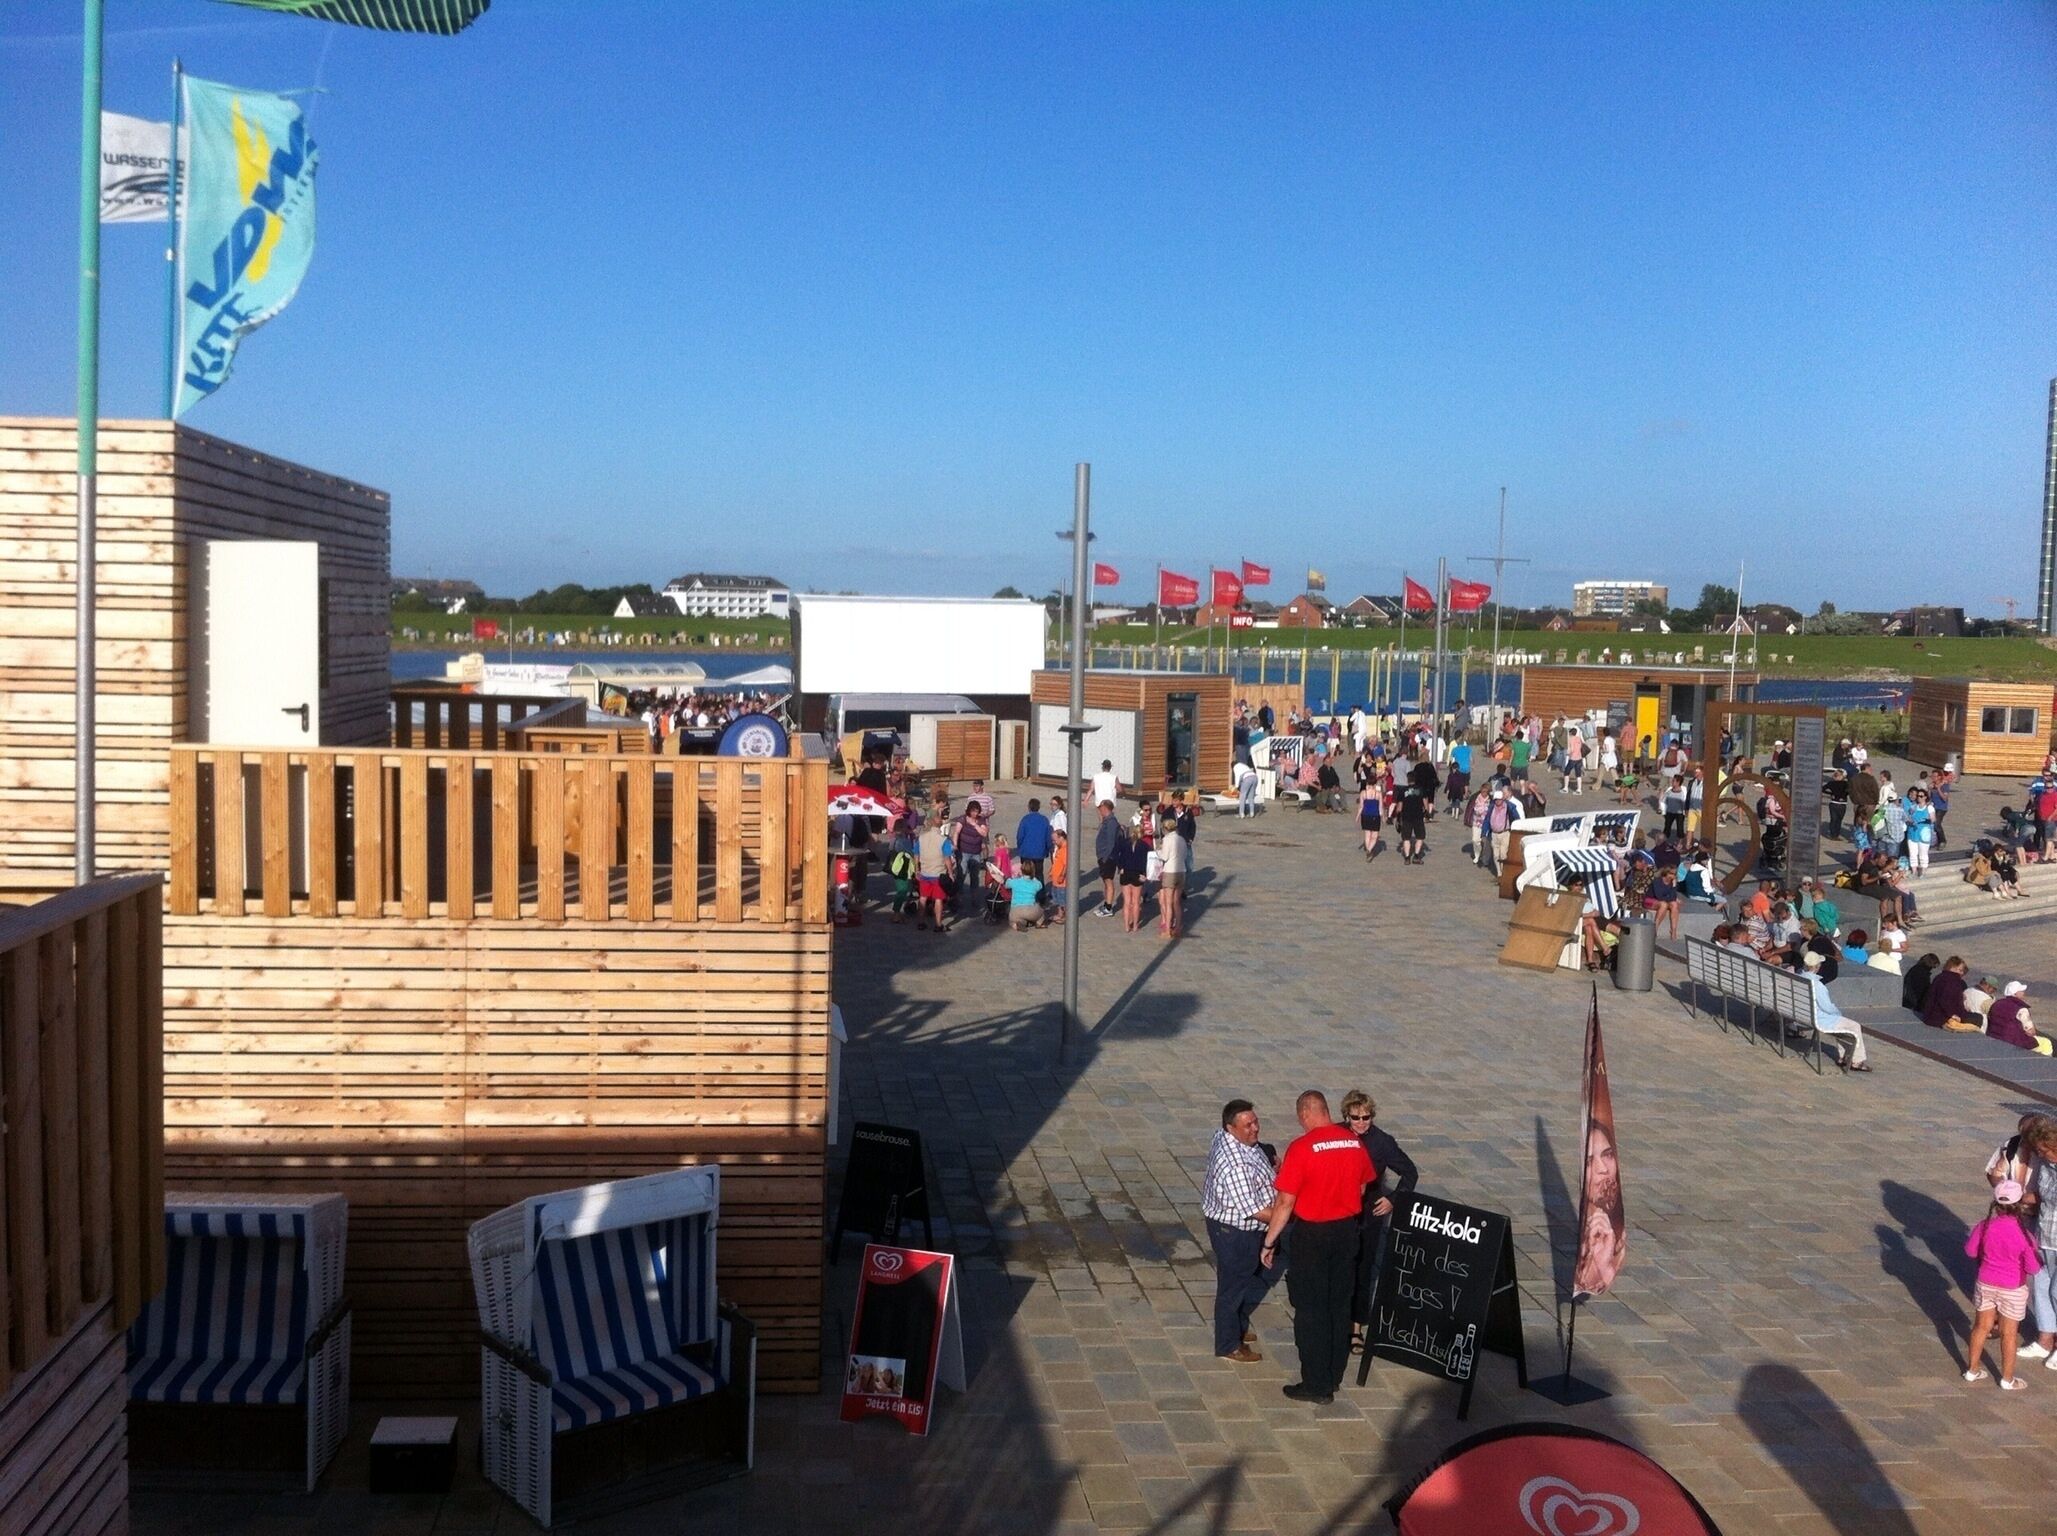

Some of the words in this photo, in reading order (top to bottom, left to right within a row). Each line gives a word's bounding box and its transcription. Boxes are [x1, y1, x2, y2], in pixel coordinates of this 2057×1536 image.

[1233, 616, 1253, 626] INFO
[1434, 1244, 1471, 1278] des
[892, 1399, 906, 1413] ein
